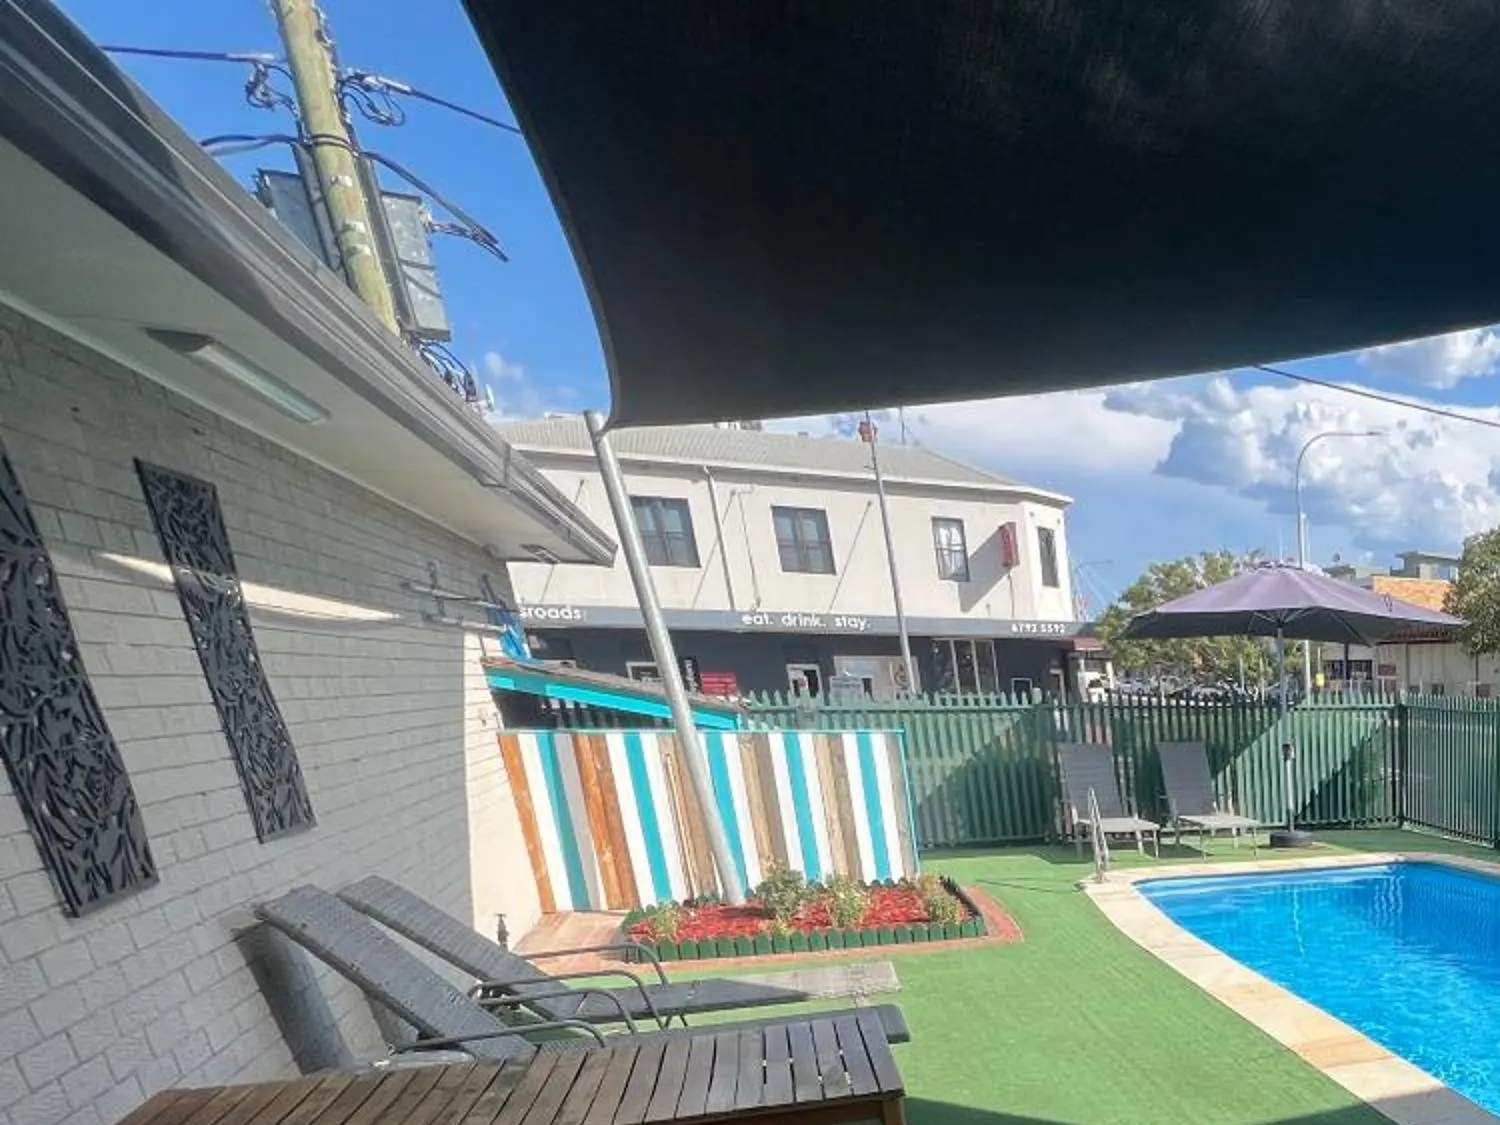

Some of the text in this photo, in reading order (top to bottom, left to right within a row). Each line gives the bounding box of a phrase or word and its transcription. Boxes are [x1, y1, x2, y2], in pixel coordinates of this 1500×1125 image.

[741, 611, 871, 631] eat. drink. stay.
